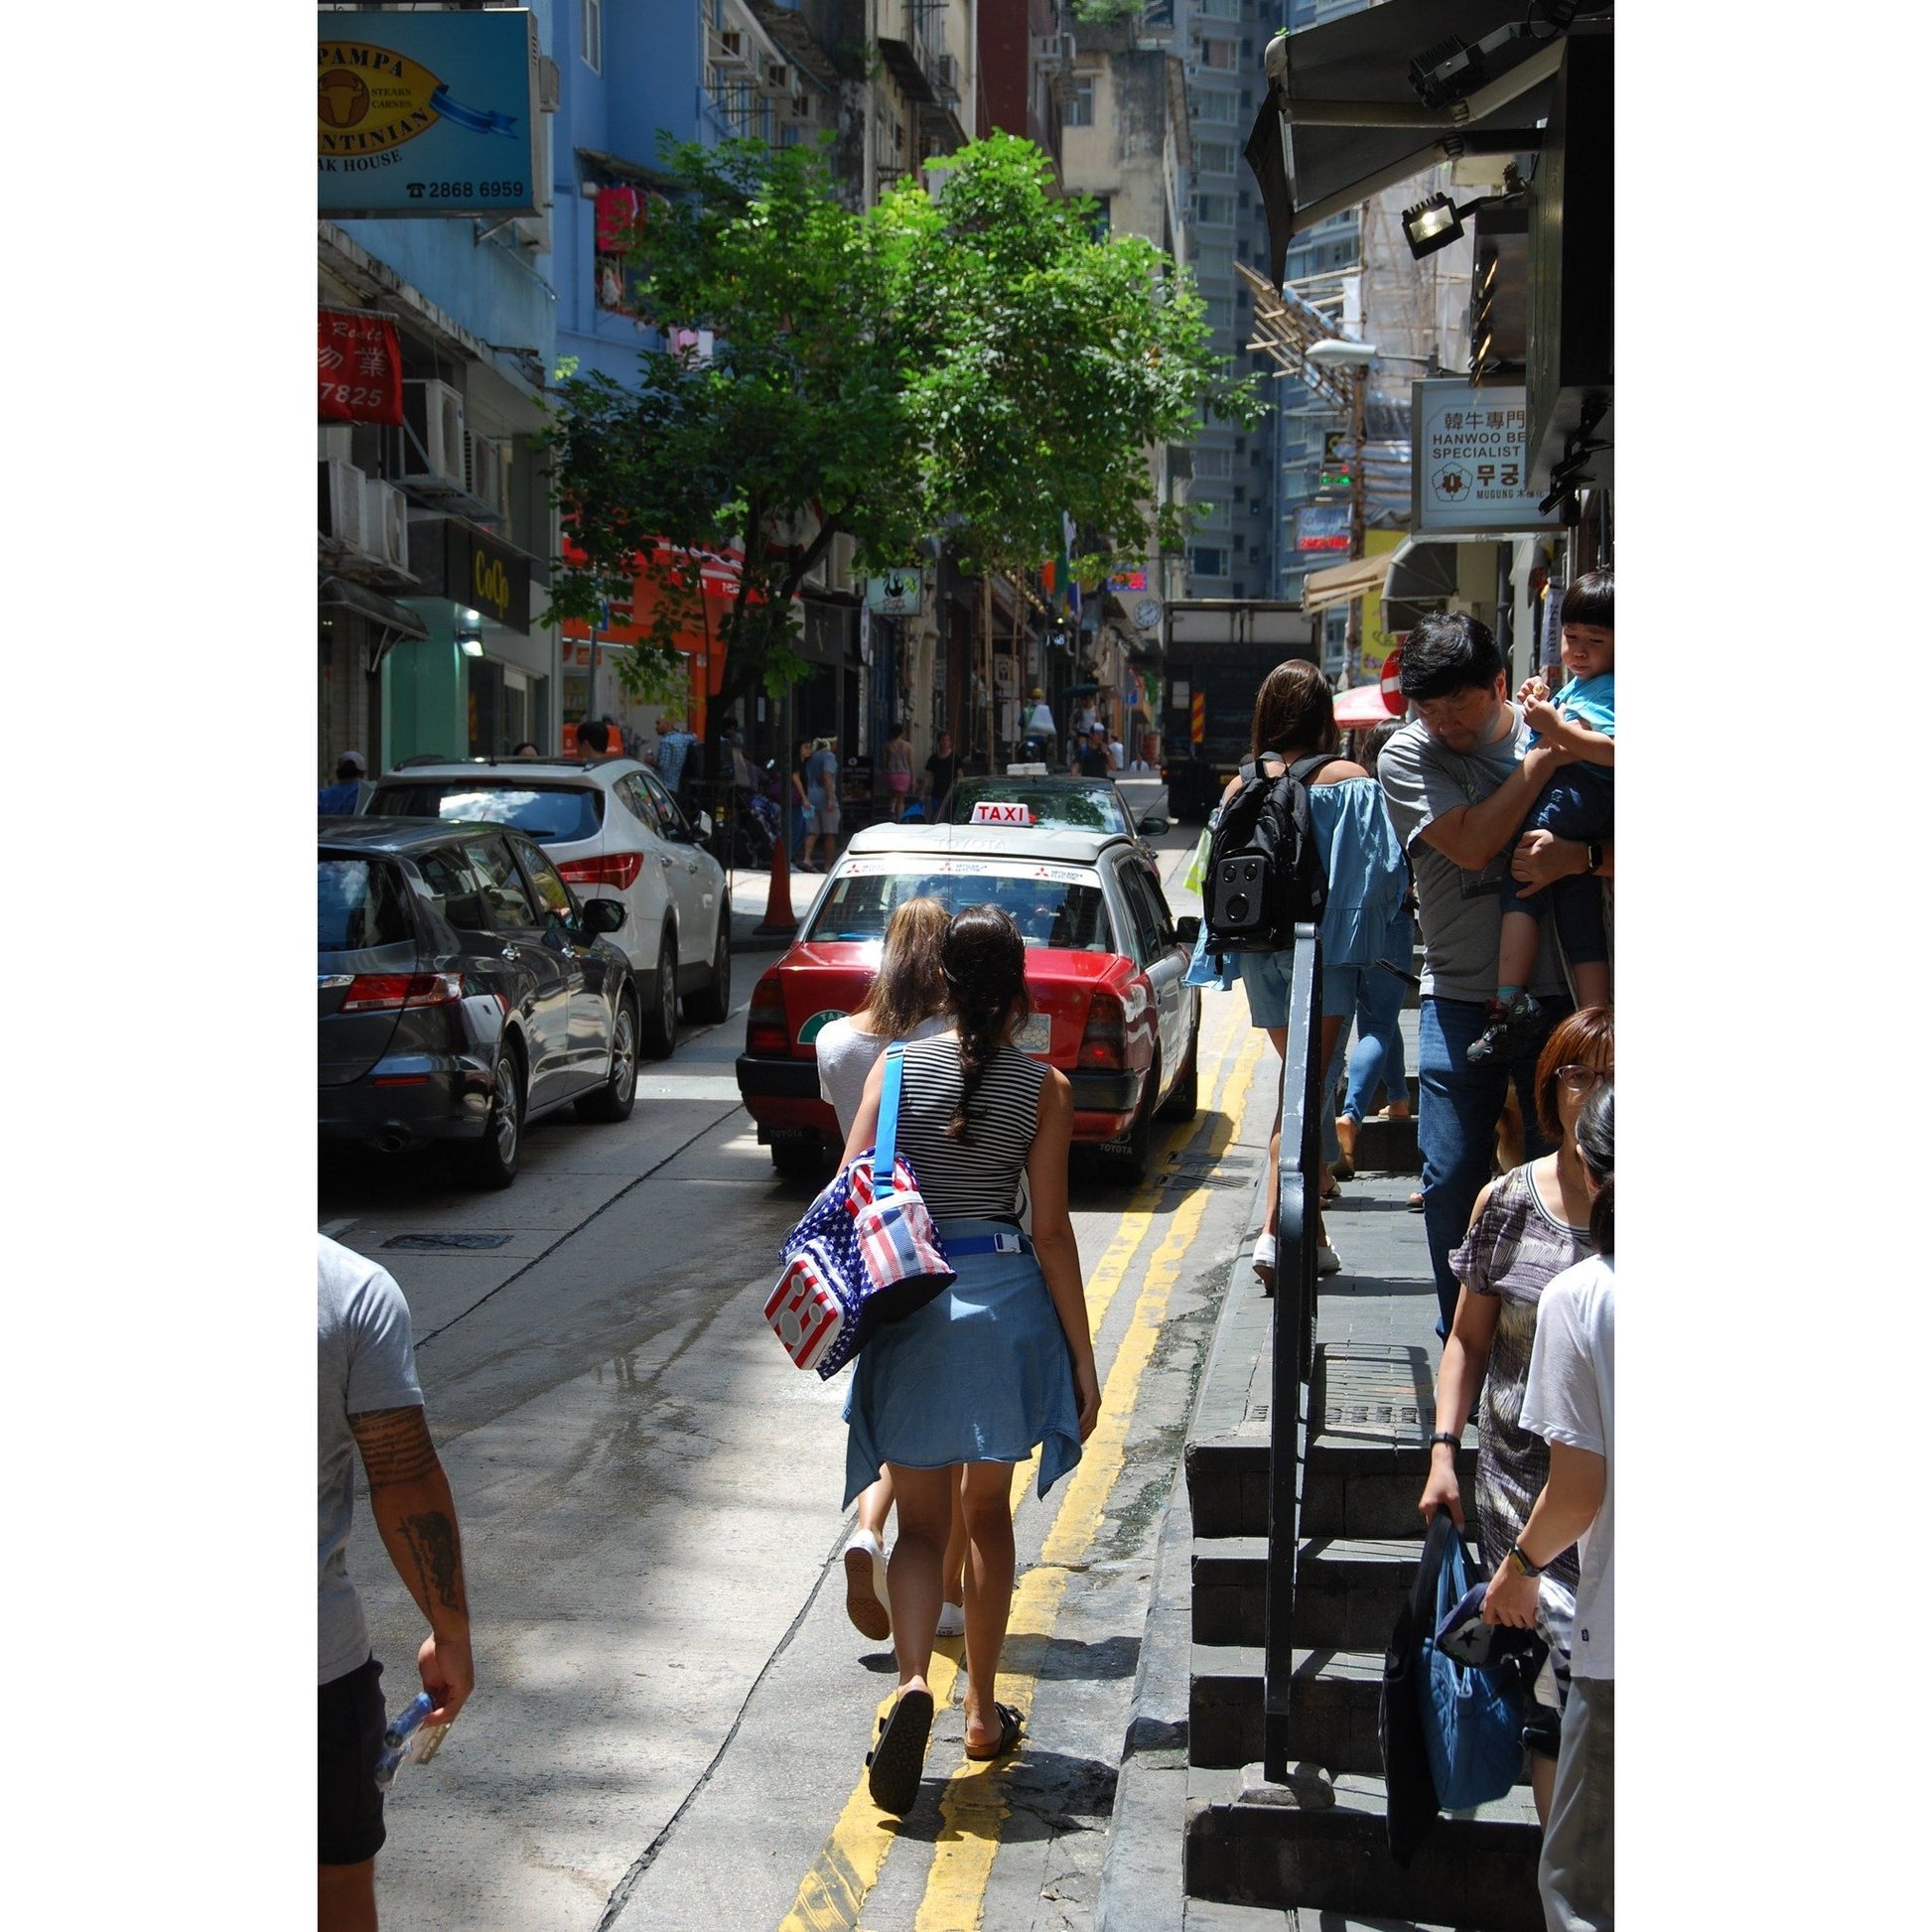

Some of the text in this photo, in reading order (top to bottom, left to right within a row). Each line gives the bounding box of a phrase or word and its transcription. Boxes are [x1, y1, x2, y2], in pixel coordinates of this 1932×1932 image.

[318, 47, 404, 78] PAMPA
[371, 87, 412, 96] STEAKS
[371, 100, 413, 109] CARNES
[344, 150, 402, 173] HOUSE
[429, 181, 524, 198] 2868 6959
[321, 381, 383, 407] 7825
[1433, 432, 1501, 445] HANWOO
[1433, 446, 1521, 459] SPECIALIST
[1476, 464, 1519, 486] 무궁
[1476, 489, 1514, 499] MUGUNG
[978, 805, 1024, 821] TAXI
[932, 836, 1008, 851] TOYOTA
[819, 1012, 843, 1021] TAX
[769, 1129, 803, 1138] TOYOTA
[1100, 1143, 1133, 1155] TOYOTA
